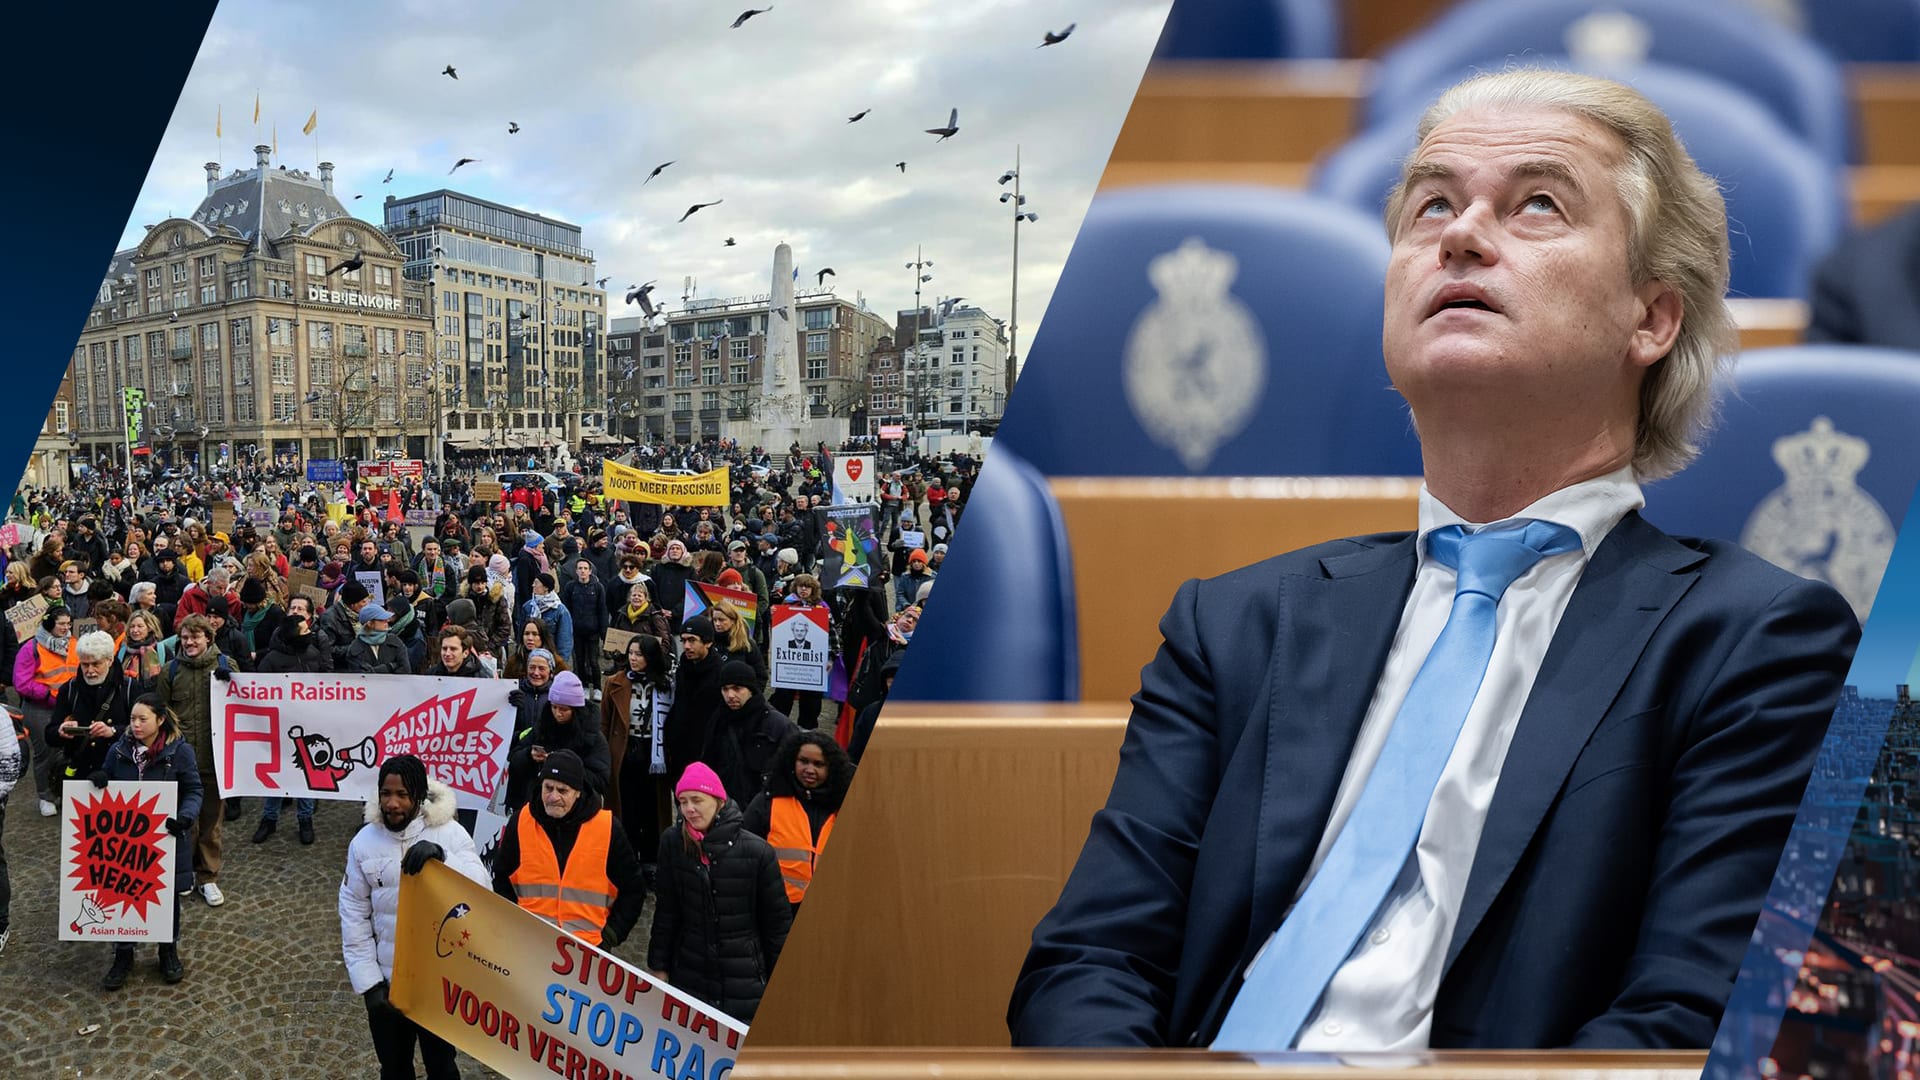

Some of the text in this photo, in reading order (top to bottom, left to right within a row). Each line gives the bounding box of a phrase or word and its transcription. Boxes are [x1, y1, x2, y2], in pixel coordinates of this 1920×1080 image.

[308, 287, 329, 303] DE
[609, 476, 722, 495] NOOIT MEER FASCISME
[776, 647, 823, 663] Extremist
[226, 680, 366, 700] Asian Raisins
[385, 731, 494, 755] OUR VOICES
[84, 809, 150, 840] LOUD
[87, 836, 158, 873] ASIAN
[89, 864, 153, 902] HERE!
[90, 927, 148, 936] Asian Raisins
[467, 951, 511, 977] EMCEMO
[551, 935, 653, 1005] STOP
[441, 976, 520, 1051] VOOR
[541, 983, 644, 1056] STOP
